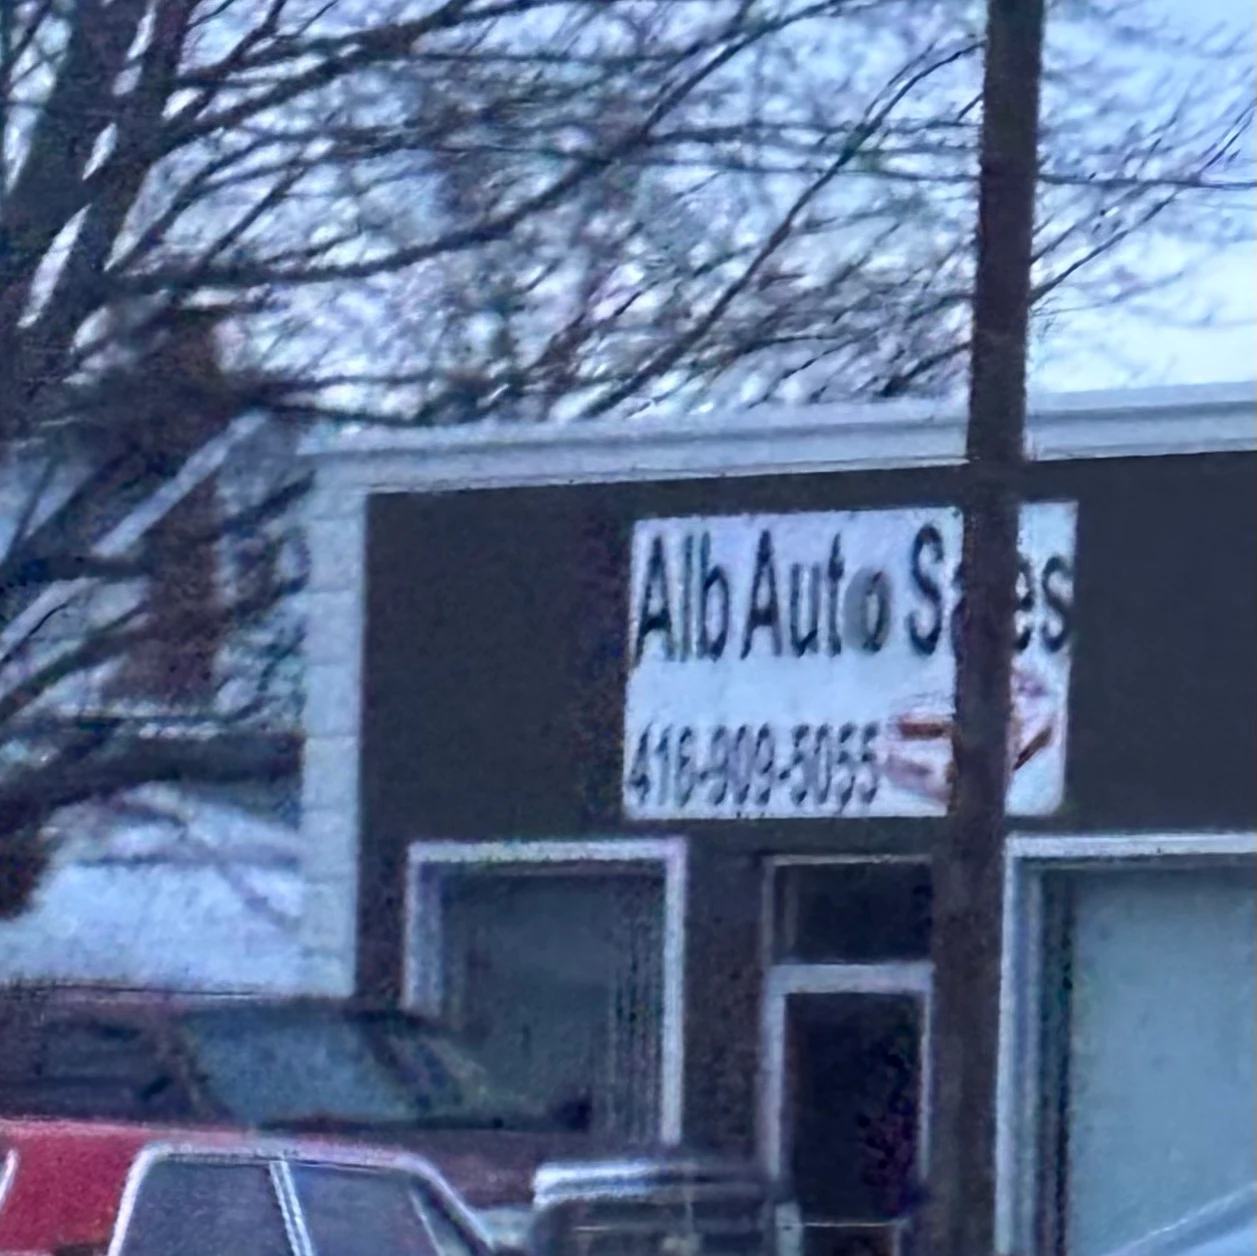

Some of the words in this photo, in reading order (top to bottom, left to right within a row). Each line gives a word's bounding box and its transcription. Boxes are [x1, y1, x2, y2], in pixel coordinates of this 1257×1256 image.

[632, 532, 729, 663] Alb
[740, 529, 892, 660] Auto
[905, 523, 1073, 658] Ses
